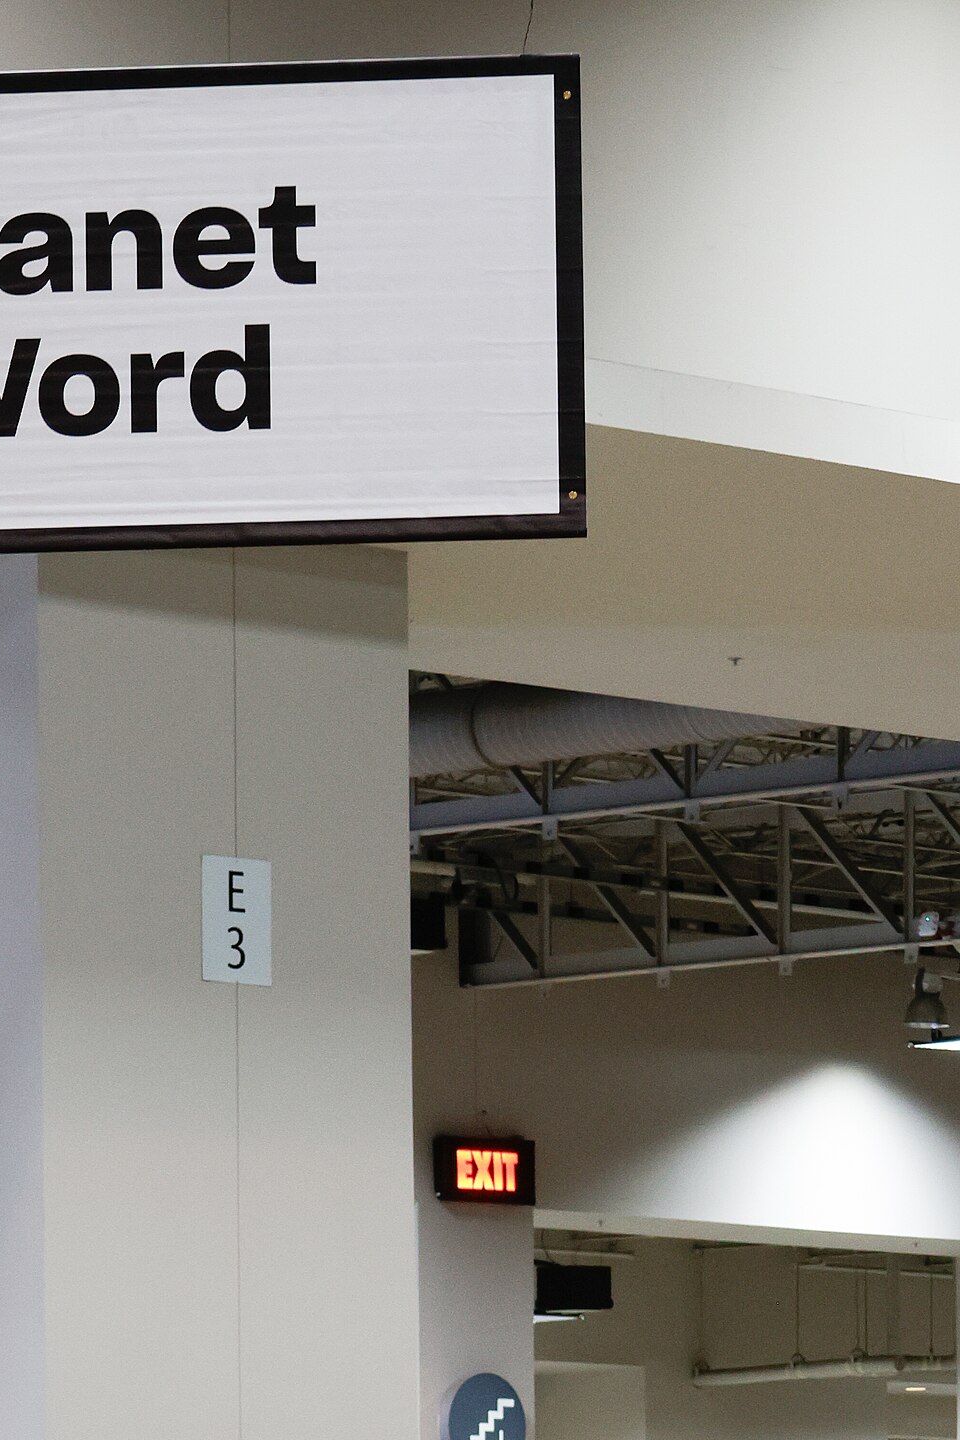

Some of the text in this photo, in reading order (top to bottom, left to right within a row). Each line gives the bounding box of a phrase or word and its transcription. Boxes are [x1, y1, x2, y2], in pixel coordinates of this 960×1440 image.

[228, 870, 246, 914] E
[227, 926, 246, 970] 3
[456, 1149, 519, 1192] EXIT
